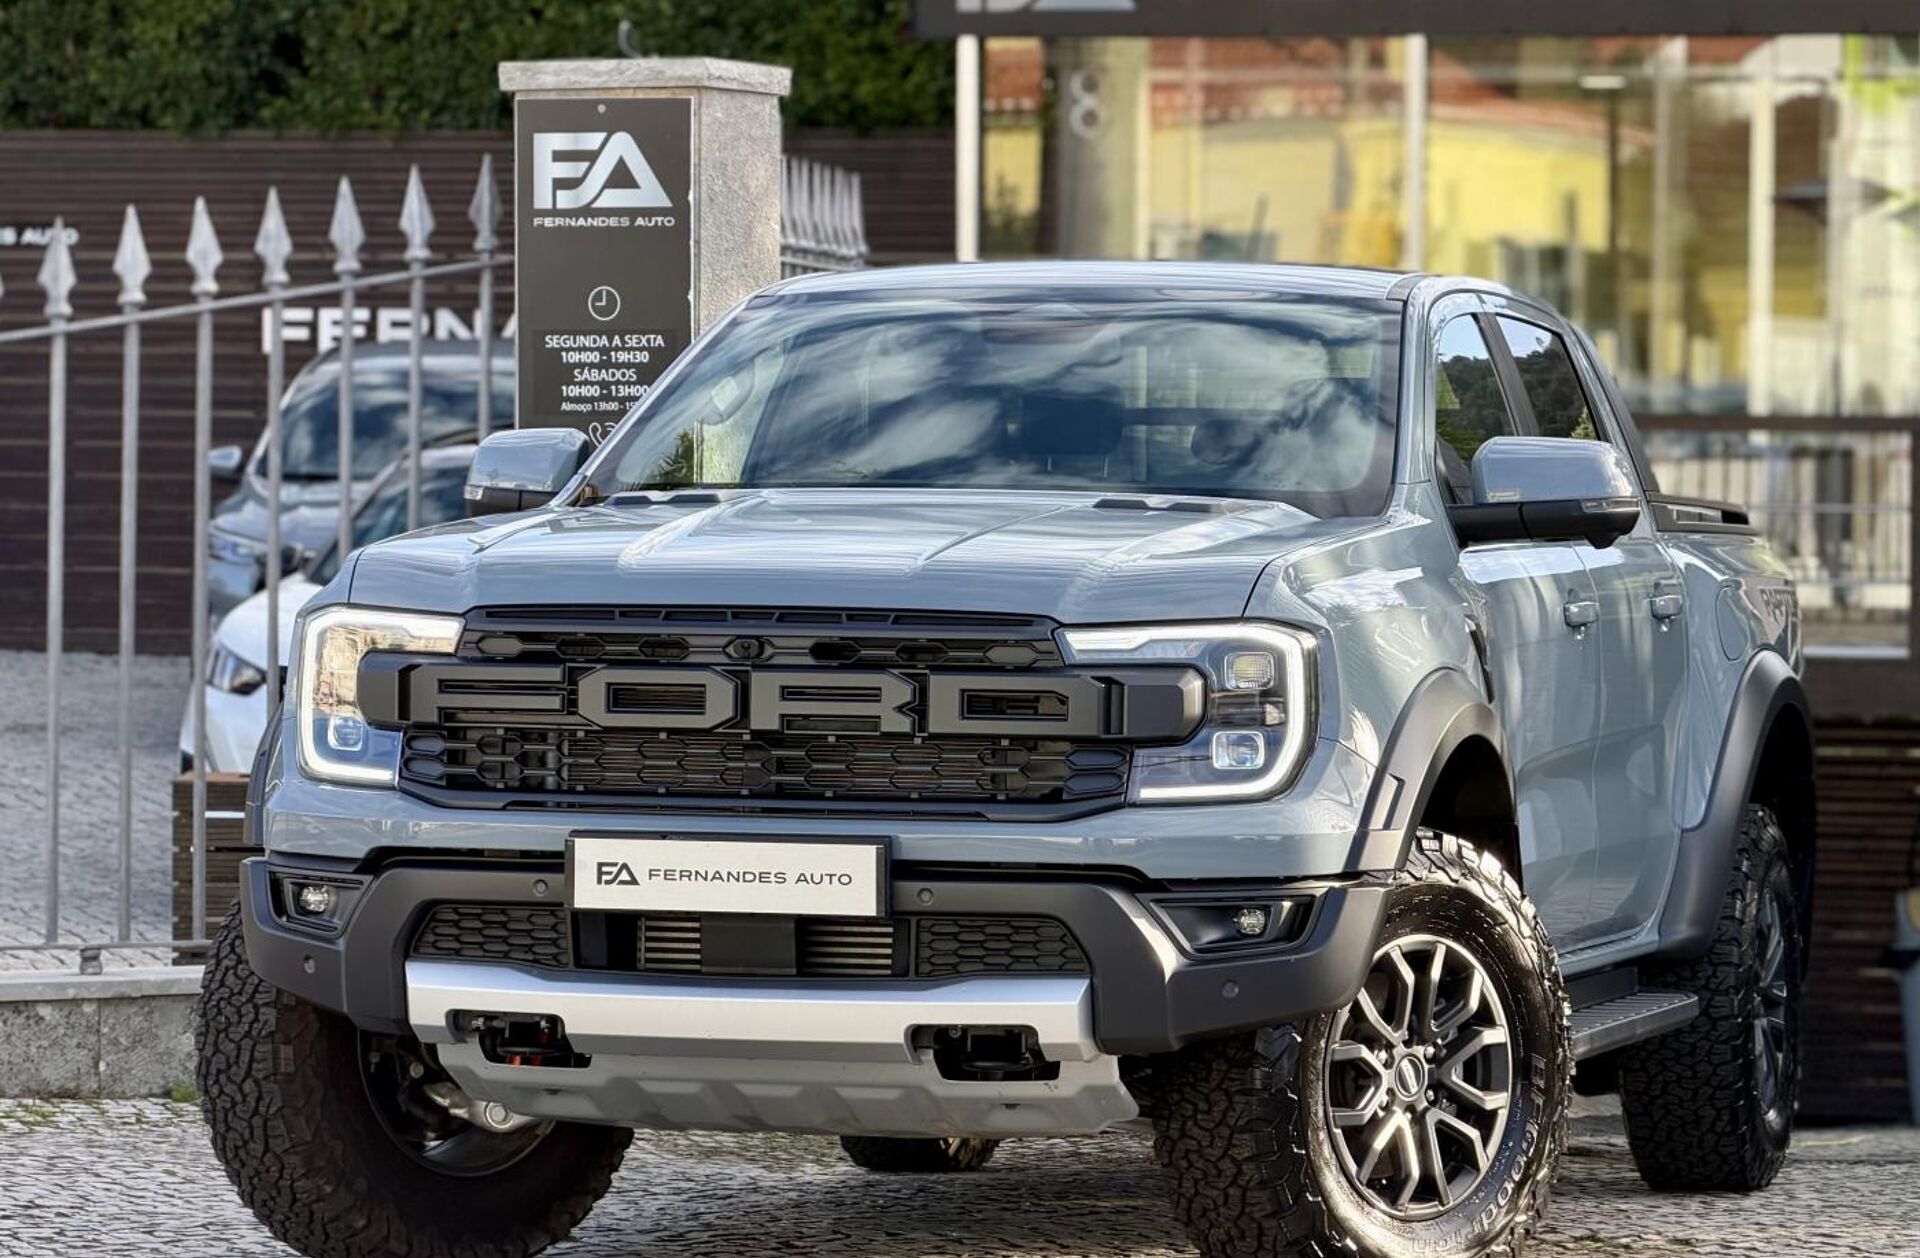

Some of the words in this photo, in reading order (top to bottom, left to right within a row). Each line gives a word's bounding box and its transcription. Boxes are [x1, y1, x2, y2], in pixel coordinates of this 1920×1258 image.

[533, 131, 673, 209] FA
[533, 217, 630, 227] FERNANDES
[634, 217, 676, 227] AUTO
[545, 335, 609, 348] SEGUNDA
[612, 335, 622, 347] A
[624, 335, 665, 347] SEXTA
[561, 351, 600, 363] 10H00
[610, 351, 650, 363] 19H30
[573, 366, 637, 382] SÁBADOS
[561, 385, 600, 397] 10H00
[560, 402, 592, 413] Almoço
[594, 402, 620, 411] 13h00
[411, 663, 1101, 738] FORD
[596, 861, 640, 886] FA
[648, 868, 787, 884] FERNANDES
[795, 872, 853, 886] AUTO
